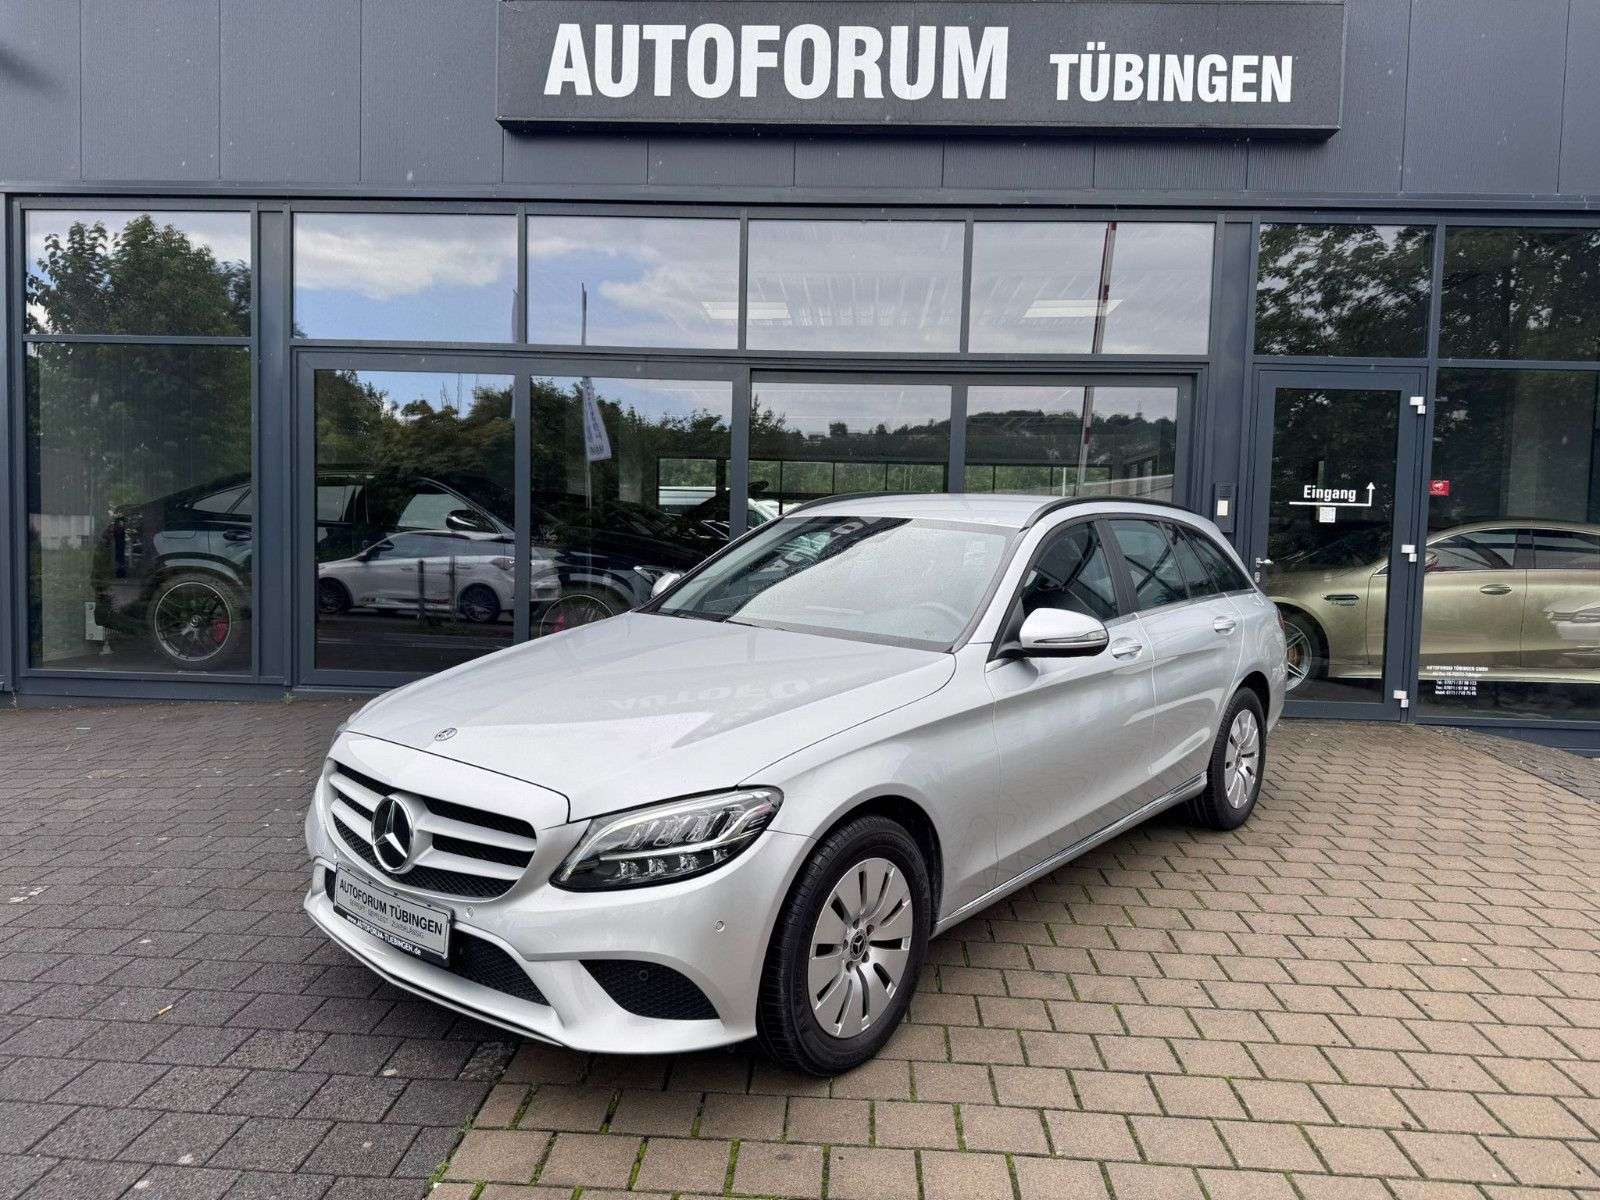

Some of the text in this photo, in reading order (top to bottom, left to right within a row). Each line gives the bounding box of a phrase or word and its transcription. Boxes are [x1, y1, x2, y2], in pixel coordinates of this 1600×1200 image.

[543, 23, 1294, 104] AUTOFORUM TÜBINGEN
[1303, 484, 1357, 502] Eingang
[340, 880, 387, 915] AUTOFORUM
[389, 904, 443, 936] TÜBINGEN
